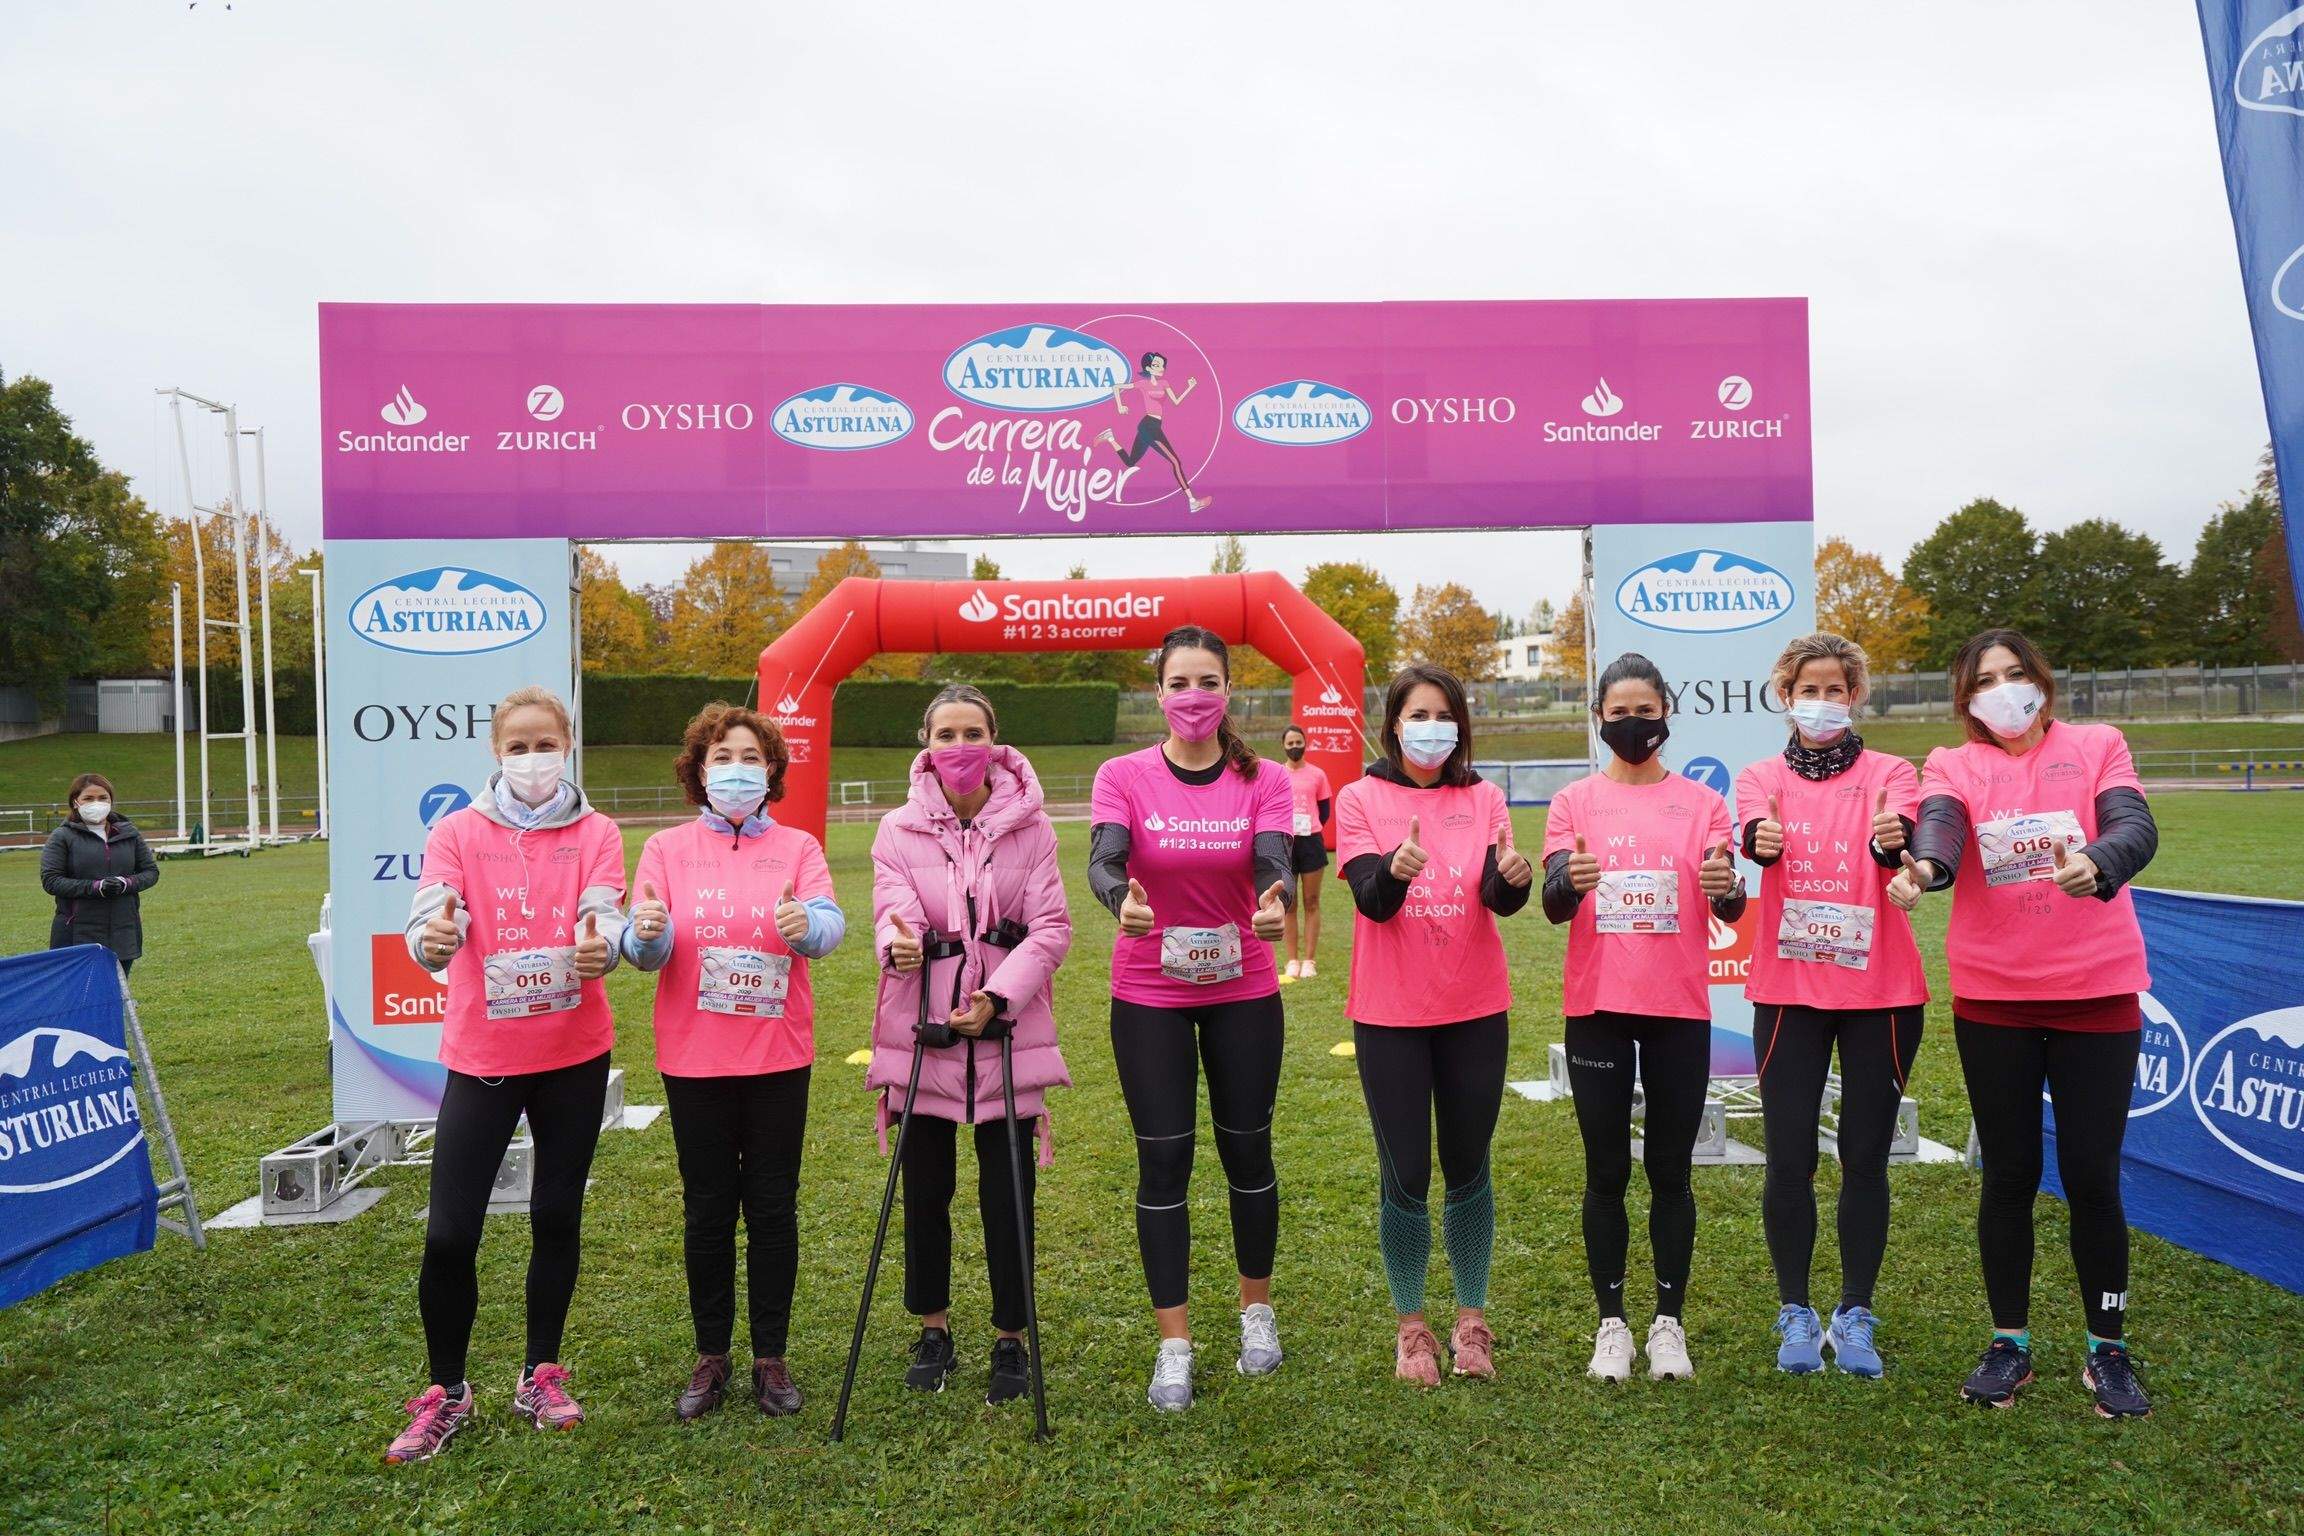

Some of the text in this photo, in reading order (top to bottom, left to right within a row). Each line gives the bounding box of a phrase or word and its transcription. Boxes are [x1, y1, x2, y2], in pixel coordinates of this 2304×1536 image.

[987, 354, 1111, 363] CENTRAL LECHERA
[958, 356, 1117, 389] ASTURIANA
[622, 403, 753, 431] OYSHO
[1243, 404, 1361, 428] ASTURIANA
[1391, 397, 1516, 424] OYSHO
[782, 408, 903, 433] ASTURIANA
[928, 406, 1082, 452] Carrera
[1543, 421, 1662, 442] Santander
[1690, 420, 1782, 439] ZURICH
[339, 430, 470, 452] Santander
[497, 431, 597, 451] ZURICH
[967, 446, 1140, 522] de la Mujer
[1656, 577, 1775, 587] CENTRAL LECHERA
[395, 597, 526, 606] CENTRAL LECHERA
[1630, 581, 1781, 612] ASTURIANA
[1003, 592, 1164, 621] Santander
[365, 600, 532, 632] ASTURIANA
[1073, 626, 1126, 638] correr
[1302, 705, 1357, 717] Santander
[1168, 816, 1251, 832] Santande
[1785, 822, 1811, 834] WE
[1608, 835, 1636, 847] WE
[2013, 837, 2052, 854] 016
[1787, 860, 1848, 873] FOR A
[1991, 873, 2021, 883] OYSHO
[496, 888, 527, 900] WE
[697, 888, 726, 900] WE
[1406, 885, 1464, 898] FOR A
[1623, 893, 1655, 905] 016
[1405, 904, 1465, 918] REASON
[497, 925, 566, 941] FOR A
[695, 926, 764, 939] FOR A
[1807, 923, 1842, 938] 016
[1188, 948, 1220, 960] 016
[516, 972, 551, 988] 016
[729, 972, 762, 988] 016
[492, 1007, 521, 1015] OYSHO
[63, 1065, 128, 1092] LECHERA
